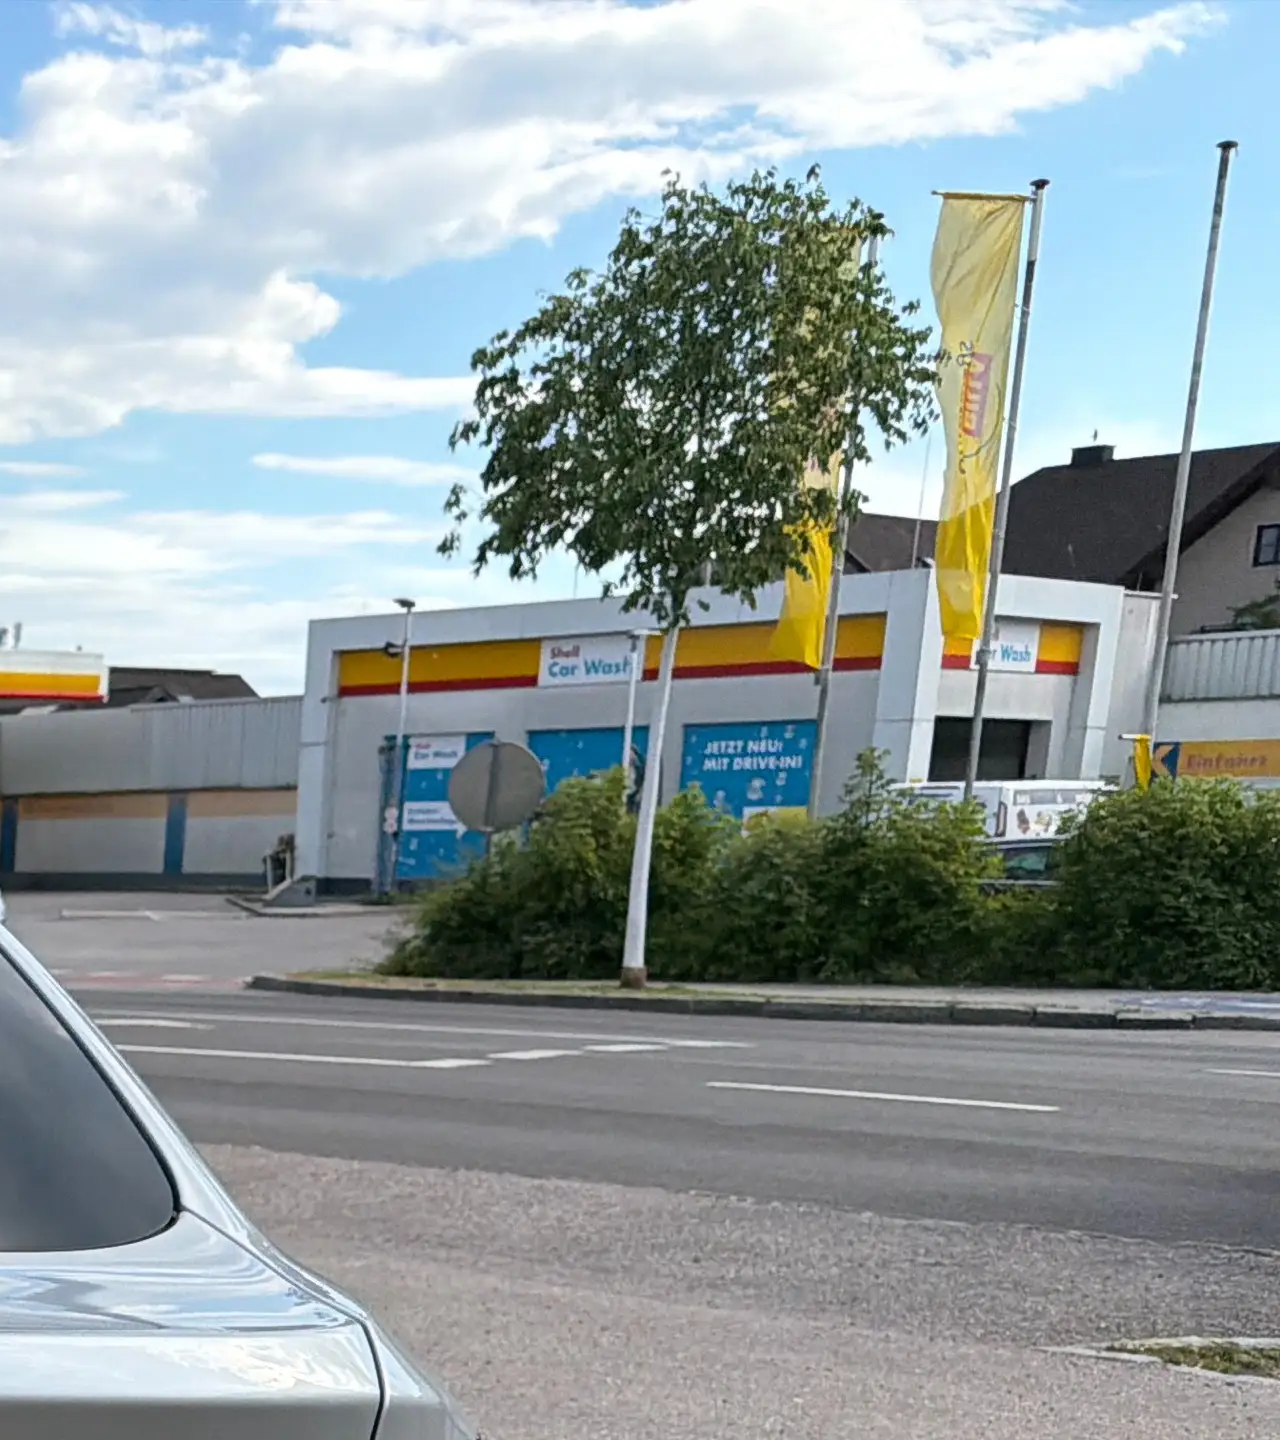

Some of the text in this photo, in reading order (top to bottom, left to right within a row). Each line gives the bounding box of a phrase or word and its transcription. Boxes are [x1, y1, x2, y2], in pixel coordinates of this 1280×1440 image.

[550, 644, 580, 659] Shell
[1000, 643, 1032, 662] Wash
[548, 655, 632, 678] Car Wash
[704, 740, 743, 755] JETZT
[702, 757, 730, 771] MIT
